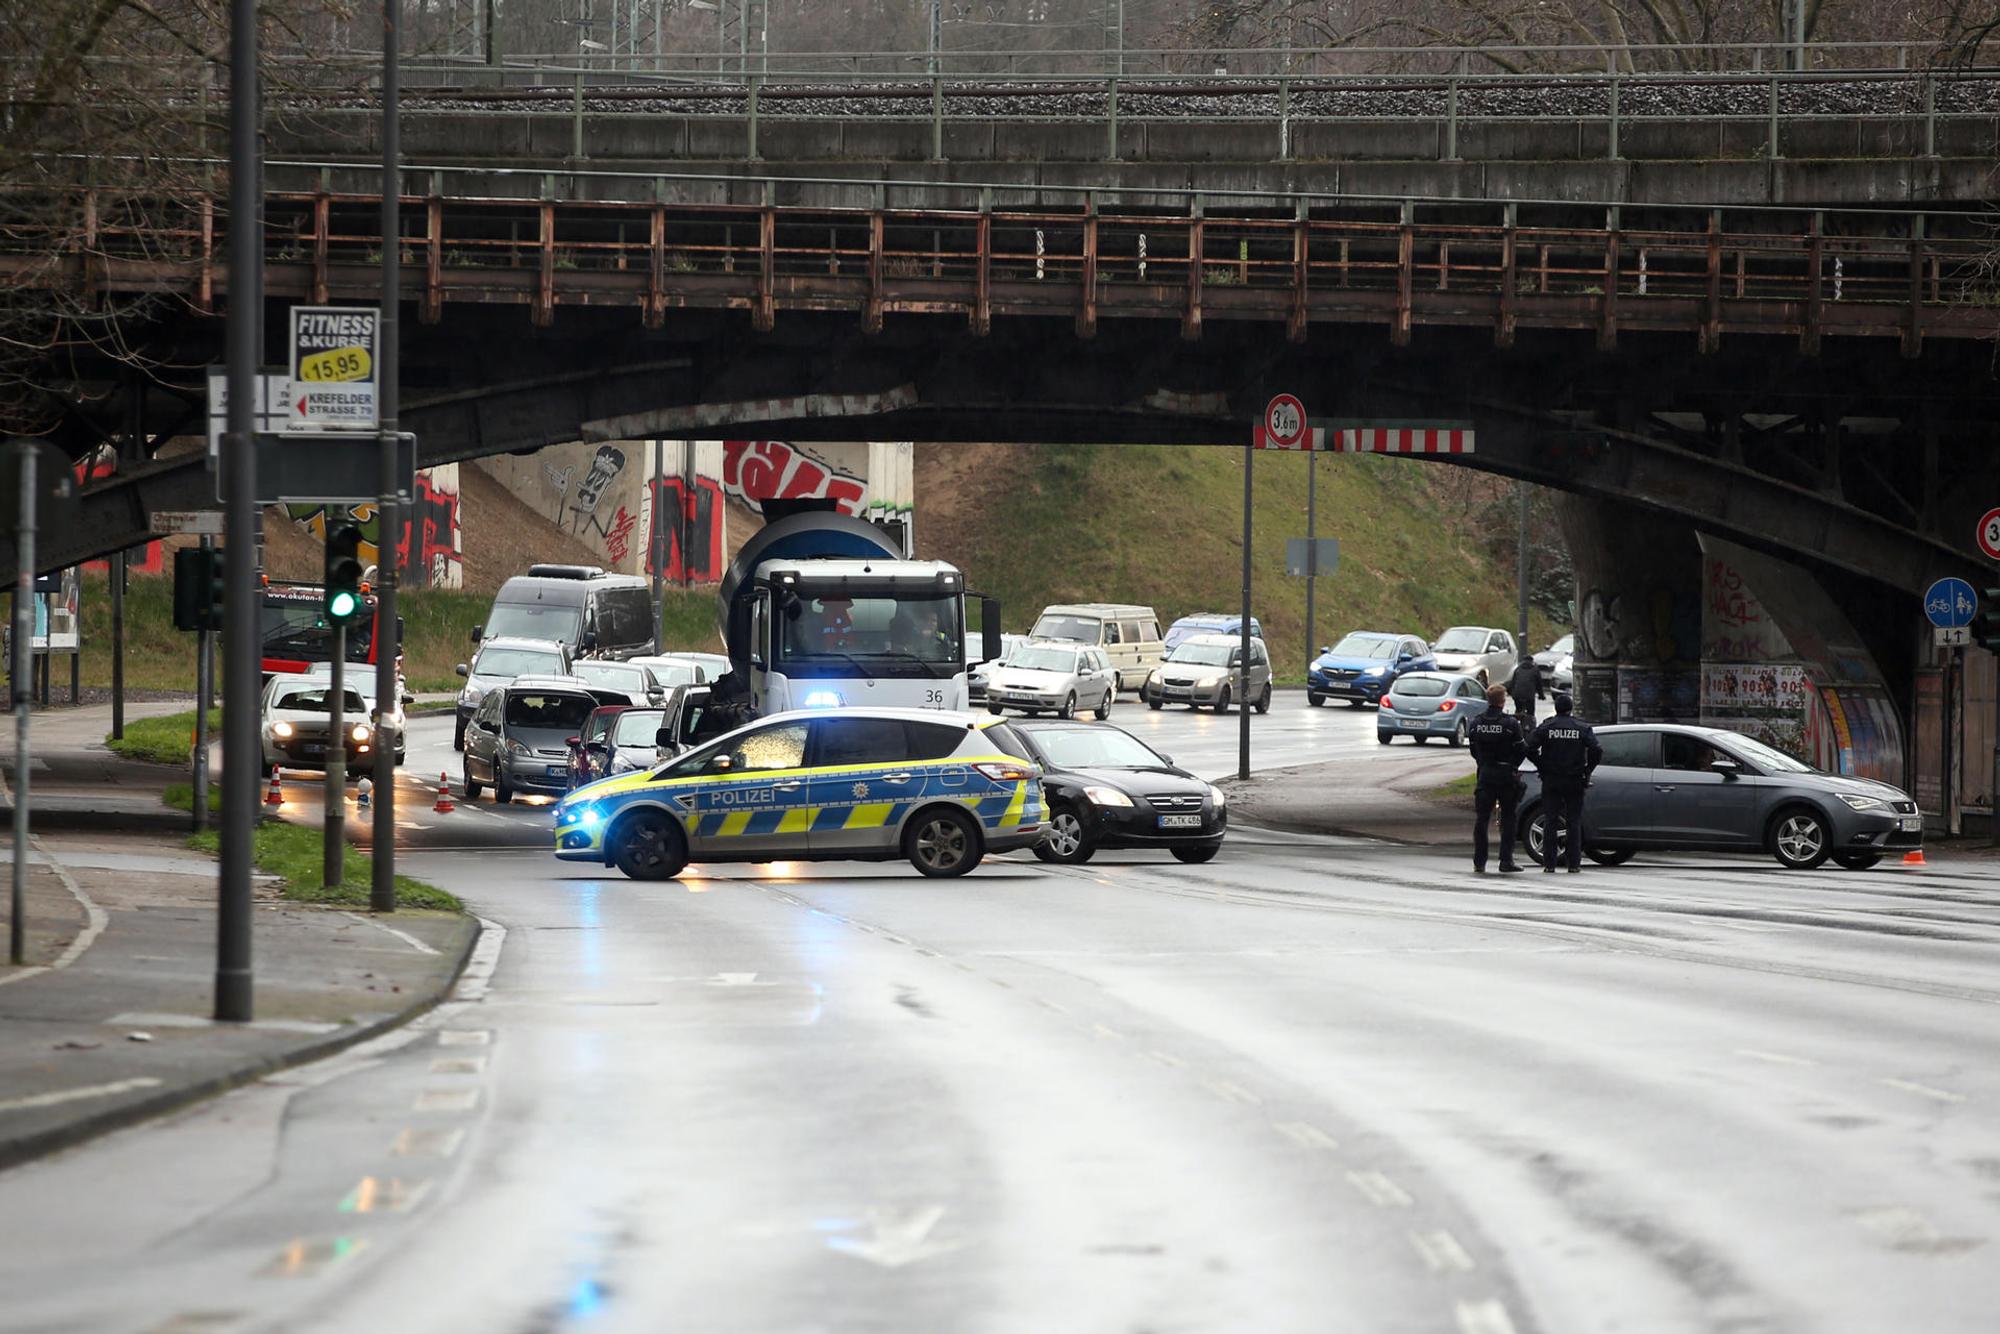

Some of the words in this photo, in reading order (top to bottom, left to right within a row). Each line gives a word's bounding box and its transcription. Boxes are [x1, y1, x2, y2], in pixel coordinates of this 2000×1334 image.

[298, 314, 373, 335] FITNESS
[312, 354, 359, 380] 15,95
[309, 393, 372, 404] KREFELDER
[309, 405, 357, 414] STRASSE
[926, 689, 943, 703] 36
[1476, 724, 1503, 734] POLIZEI
[1548, 729, 1580, 739] POLIZEI
[711, 788, 775, 805] POLIZEI
